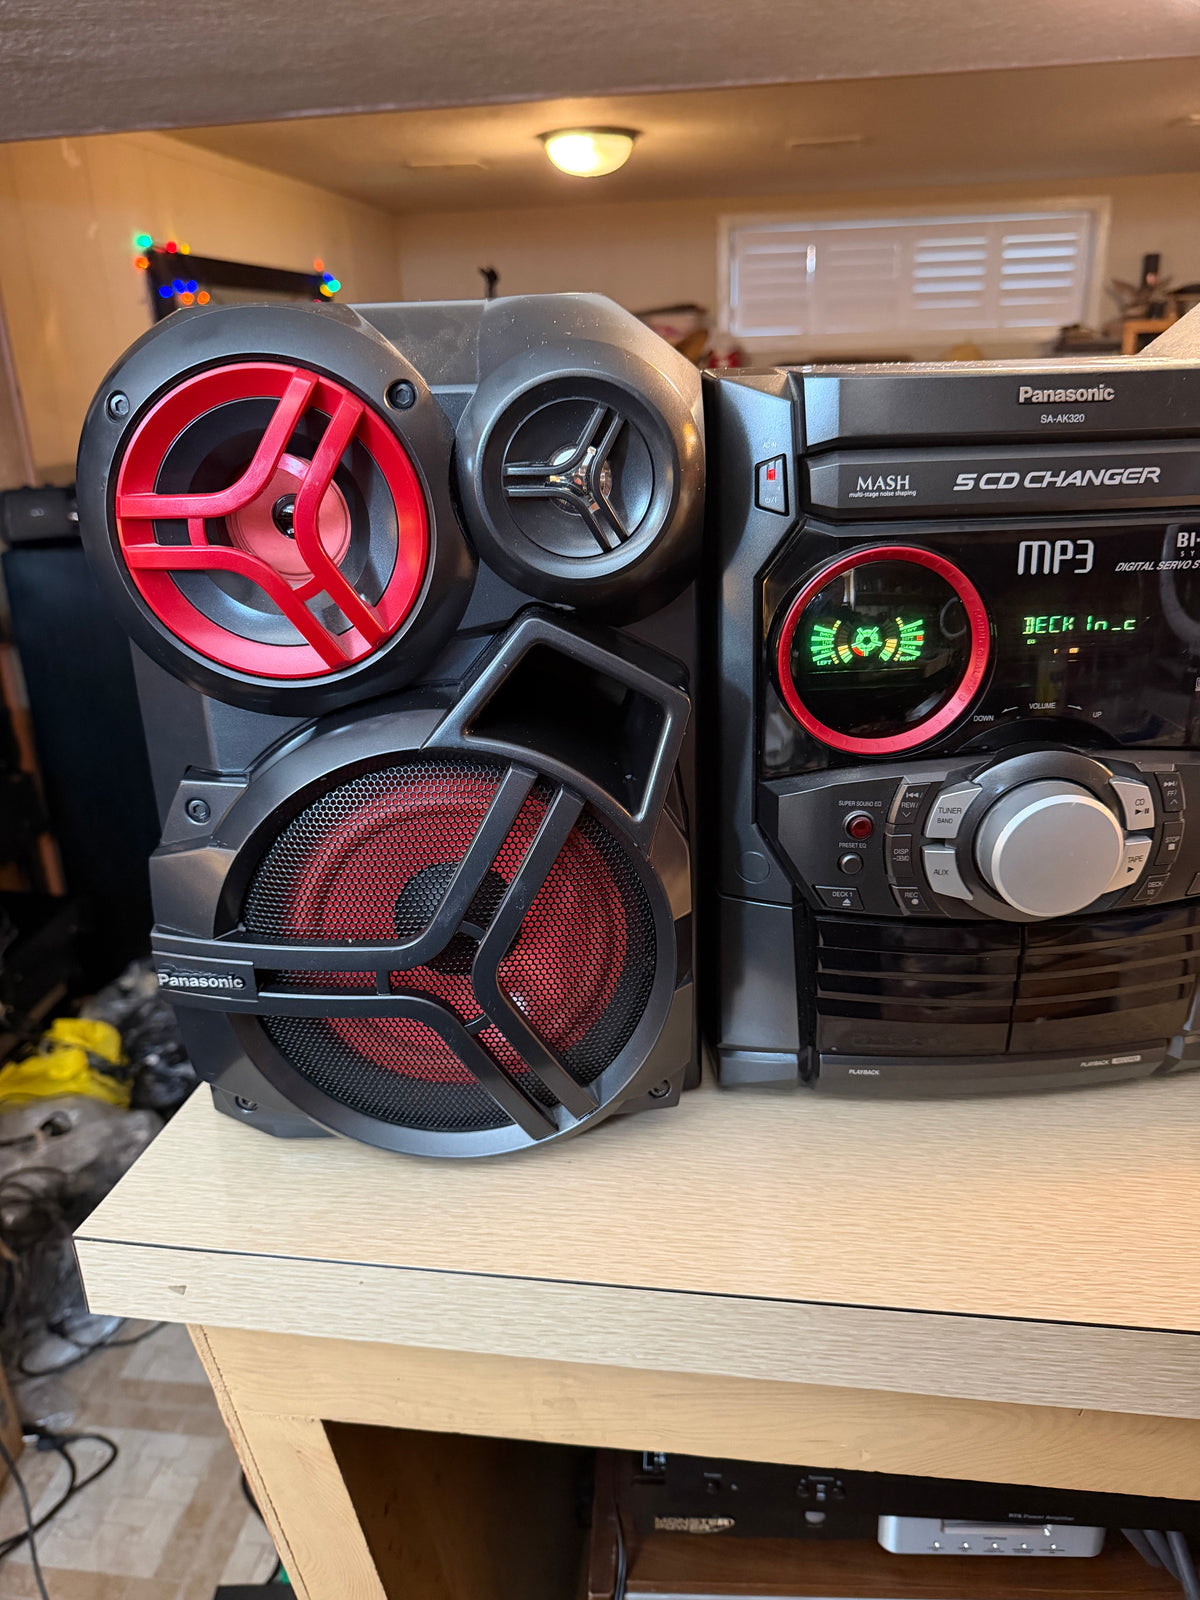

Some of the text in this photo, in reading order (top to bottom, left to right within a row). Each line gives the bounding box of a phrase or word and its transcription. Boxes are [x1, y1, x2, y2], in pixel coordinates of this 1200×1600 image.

[1018, 383, 1116, 404] Panasonic
[1040, 413, 1086, 424] SA-AK320
[856, 475, 910, 490] MASH
[1023, 467, 1162, 488] CHANGER
[895, 489, 917, 497] shaping
[1017, 539, 1095, 575] MP3
[1115, 561, 1155, 572] DIGITAL
[1156, 560, 1192, 571] SERVO
[1022, 615, 1075, 635] DECK
[1028, 701, 1057, 710] VOLUME
[973, 714, 995, 722] DOWN
[1092, 711, 1103, 719] UP
[938, 806, 962, 814] TUNER
[1165, 836, 1180, 844] STOP
[1128, 854, 1145, 863] TAPE
[933, 868, 949, 876] AUX
[157, 973, 244, 988] Panasonic
